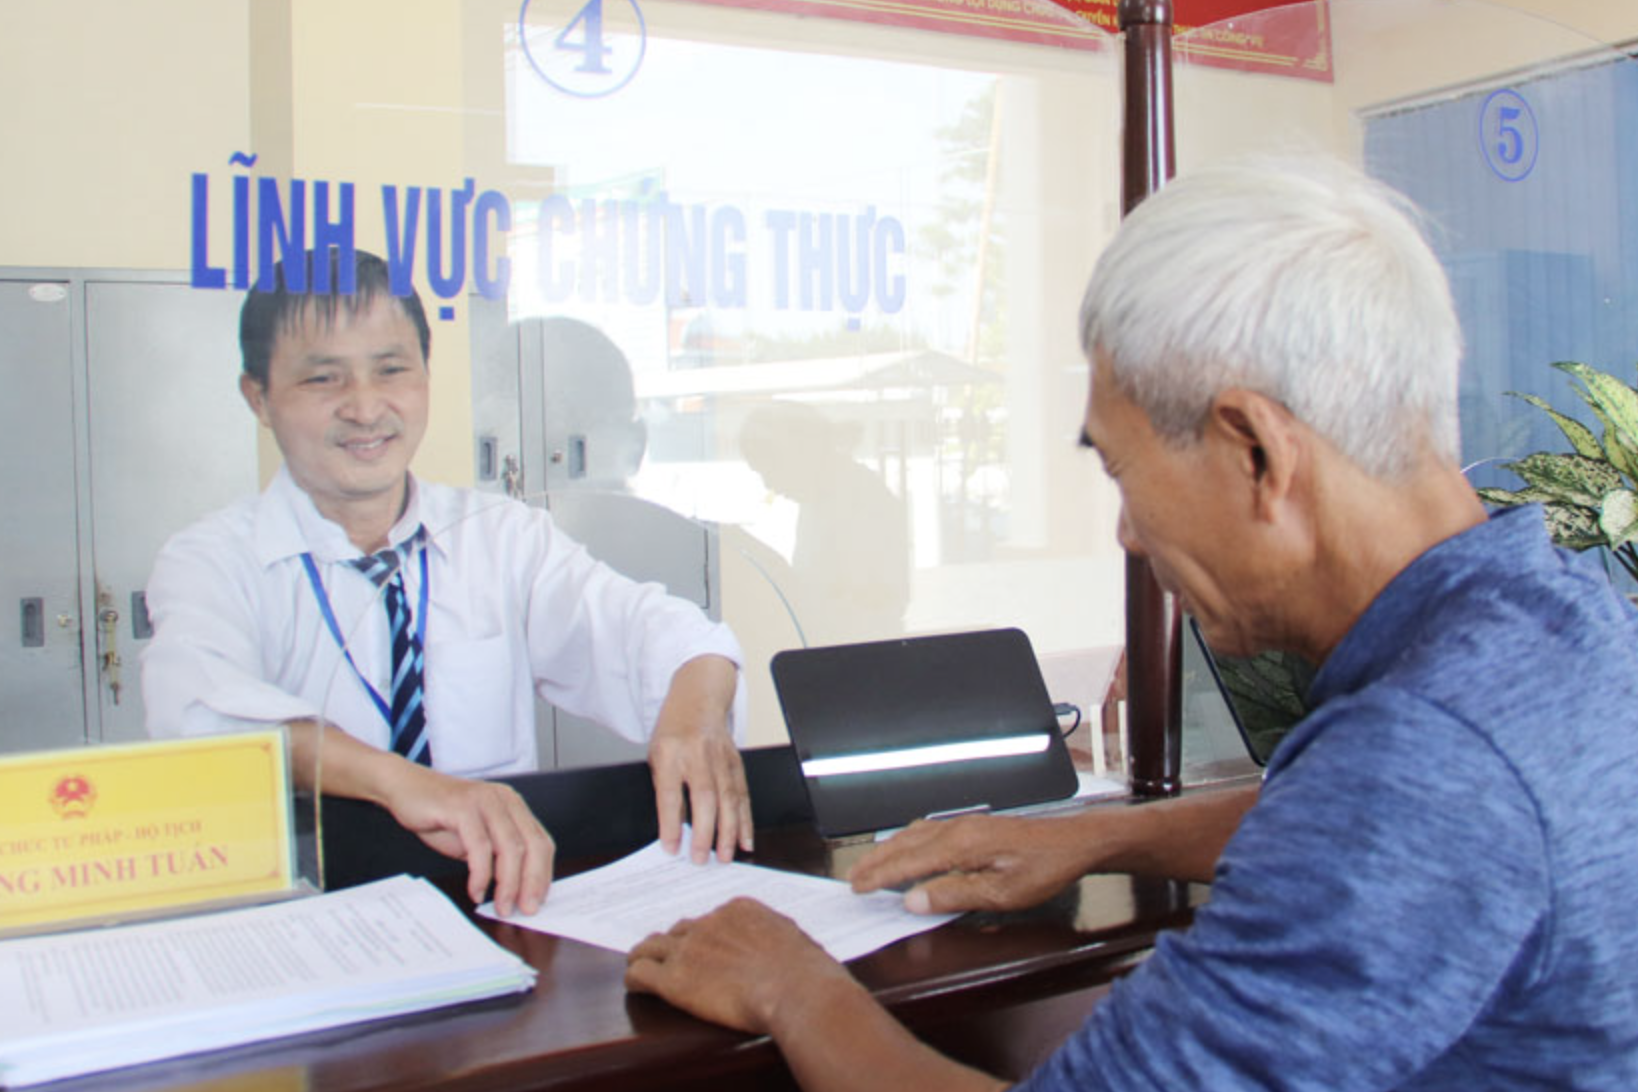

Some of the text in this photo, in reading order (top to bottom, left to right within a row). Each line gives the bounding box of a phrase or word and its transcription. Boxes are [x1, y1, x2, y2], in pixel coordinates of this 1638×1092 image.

[554, 0, 613, 74] 4
[1498, 106, 1524, 164] 5
[190, 151, 906, 331] LĨNH VỰC CHỨNG THỰC
[51, 855, 138, 889] MINH
